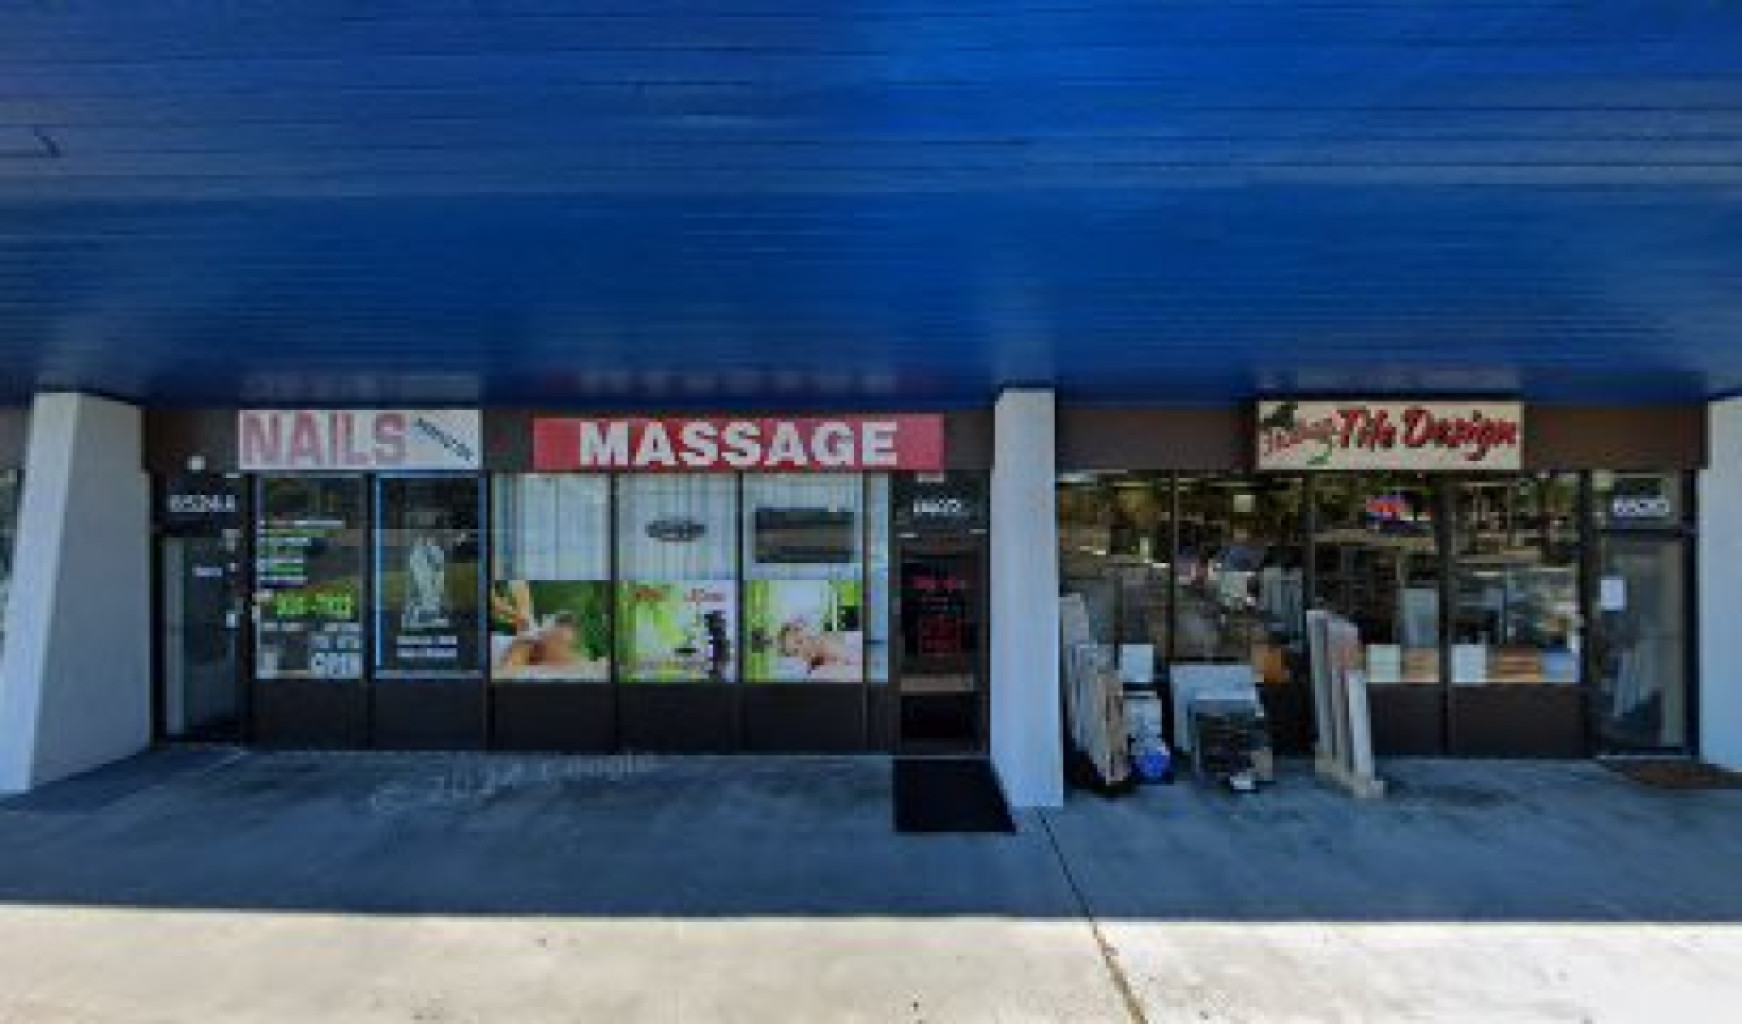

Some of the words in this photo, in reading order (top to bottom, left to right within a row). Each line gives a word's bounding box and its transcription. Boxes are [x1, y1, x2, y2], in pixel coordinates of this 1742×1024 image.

[243, 411, 407, 465] NAILS
[579, 421, 898, 466] MASSAGE
[1402, 406, 1517, 461] Design
